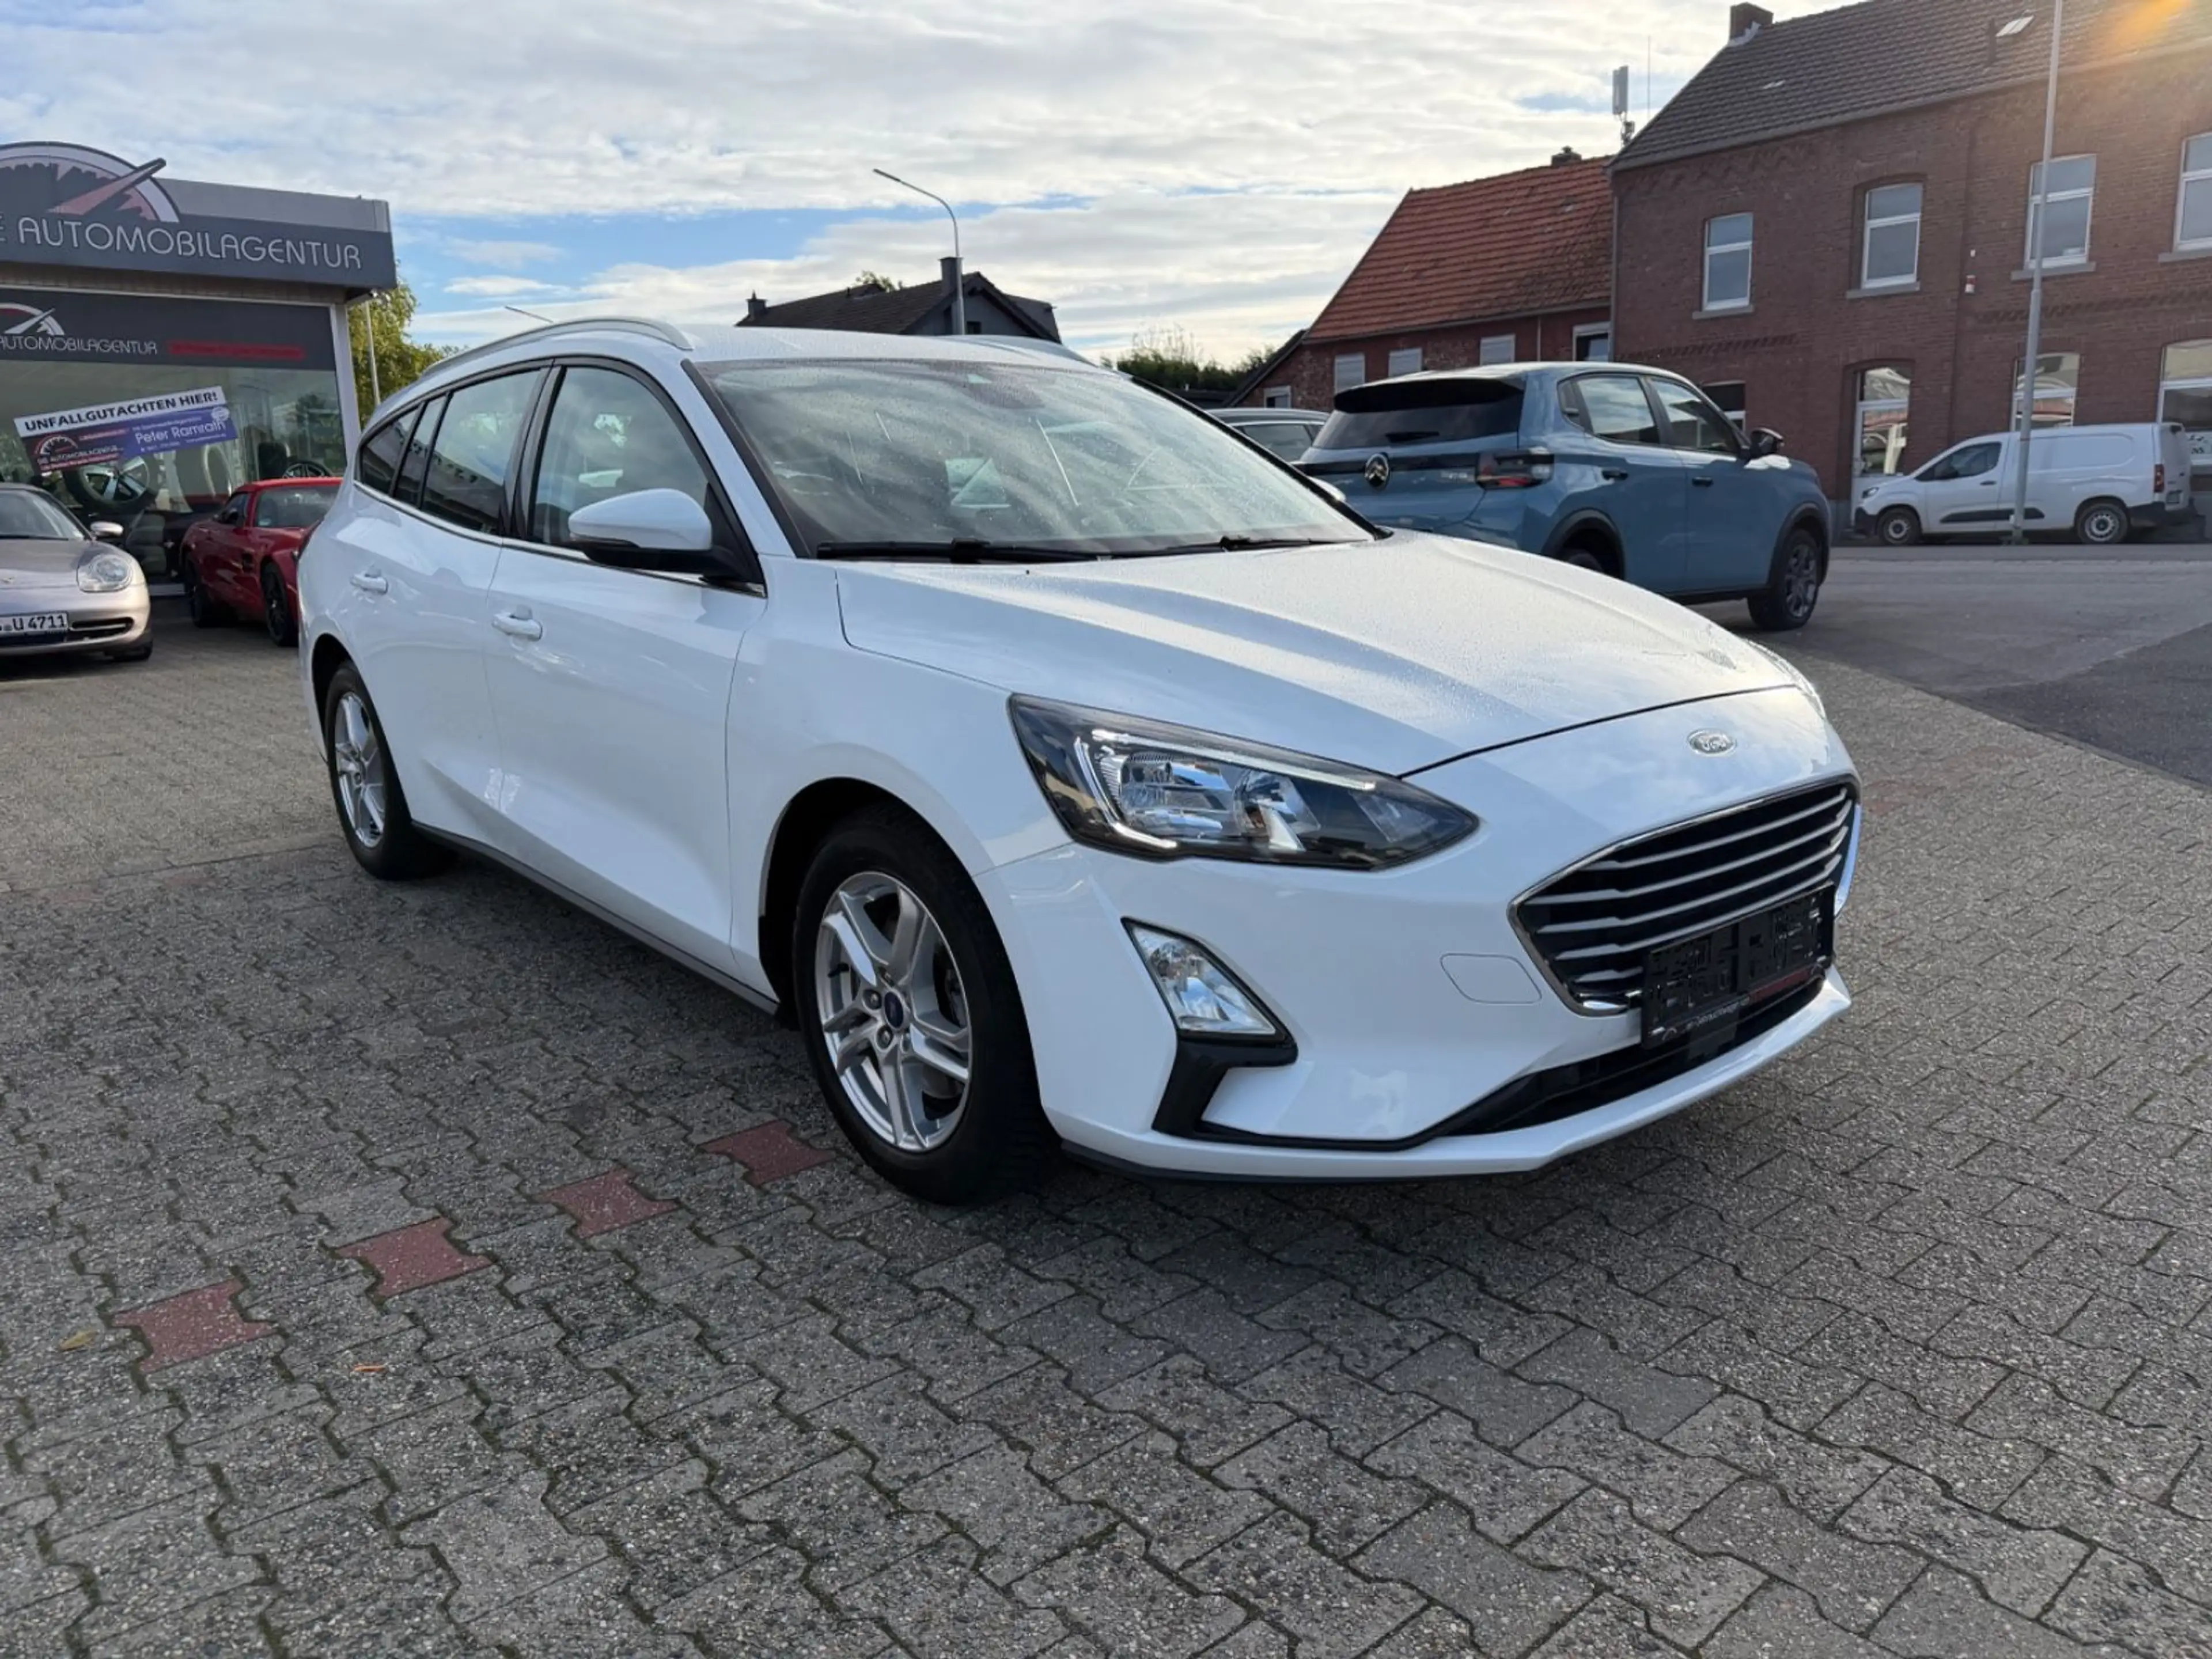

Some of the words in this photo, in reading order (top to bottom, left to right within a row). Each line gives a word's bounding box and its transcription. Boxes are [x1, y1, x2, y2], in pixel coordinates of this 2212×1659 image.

[18, 217, 361, 269] AUTOMOBILAGENTUR
[25, 397, 176, 431] UNFALLGUTACHTEN
[179, 391, 218, 407] HIER!
[135, 430, 169, 444] Peter
[12, 618, 24, 631] U
[28, 615, 65, 630] 4711
